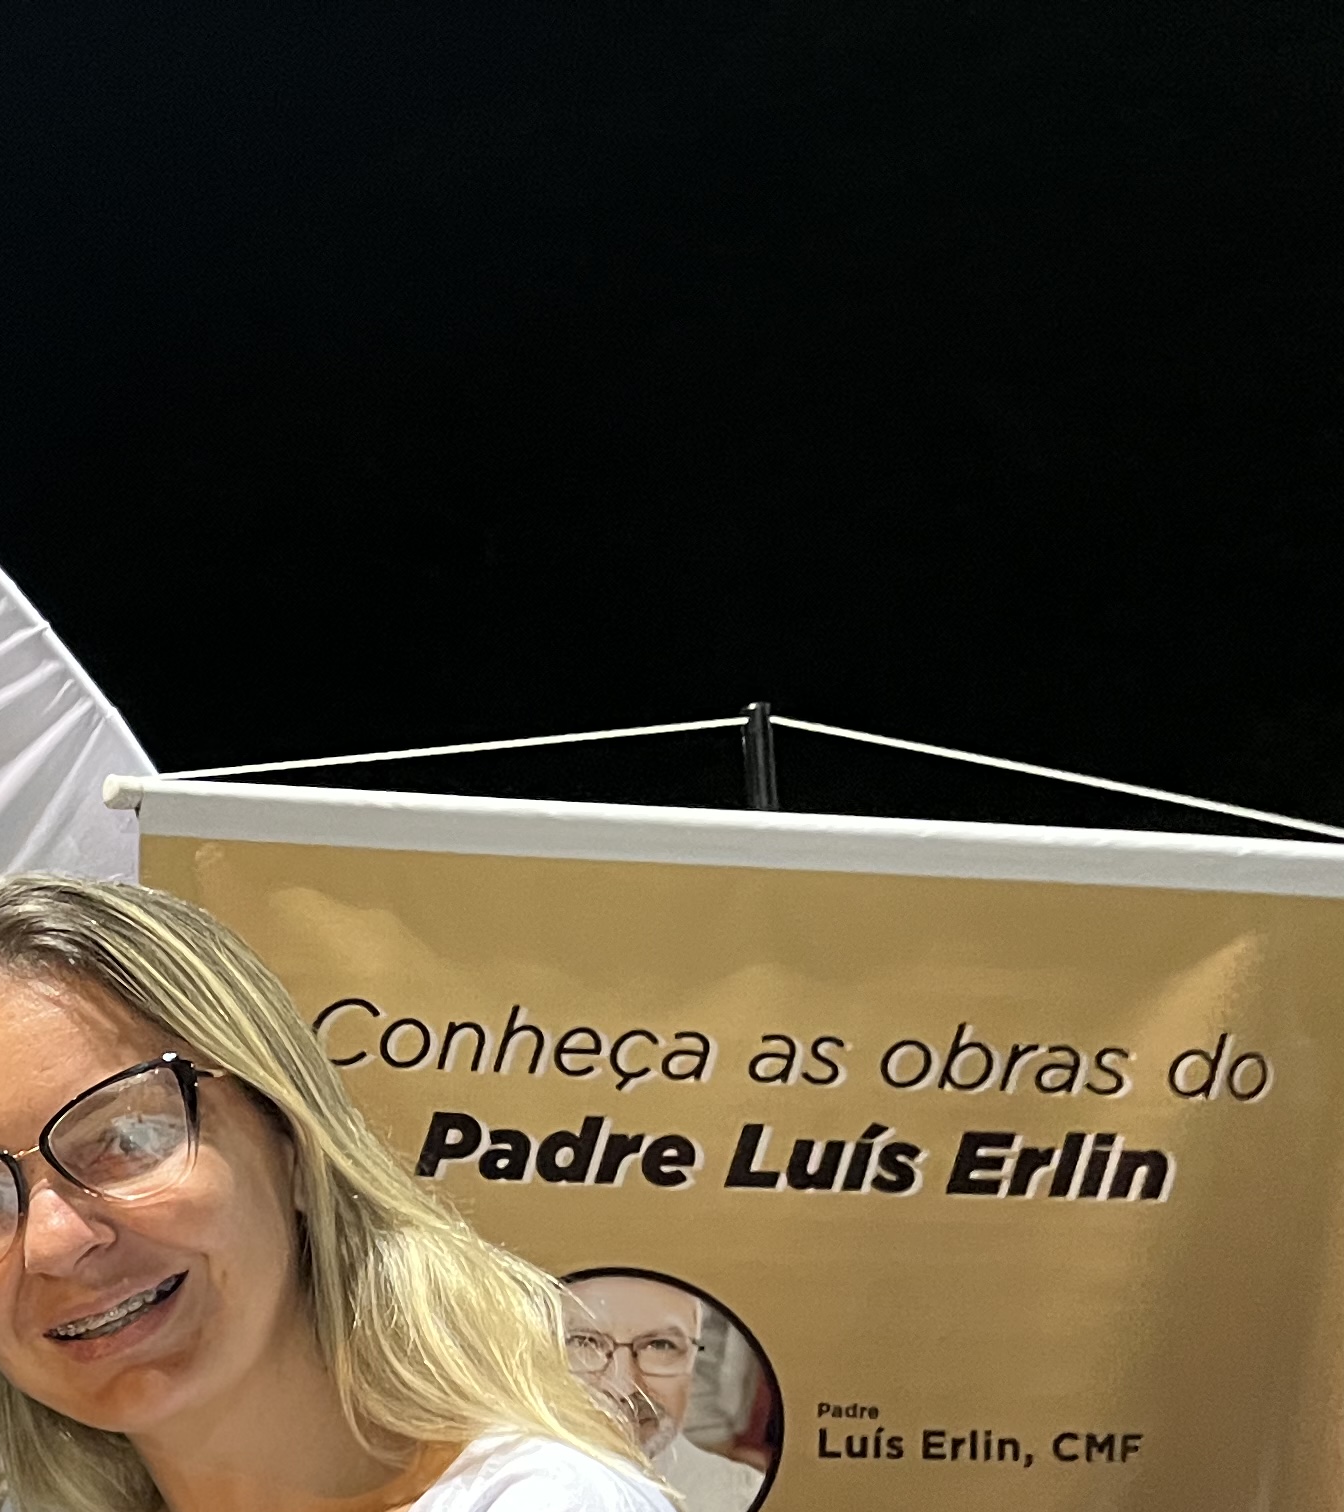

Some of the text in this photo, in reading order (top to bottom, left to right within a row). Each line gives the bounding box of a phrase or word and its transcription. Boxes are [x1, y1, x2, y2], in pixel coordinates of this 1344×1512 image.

[312, 998, 1270, 1100] Conheça as obras do
[415, 1111, 1172, 1200] Padre Luís Erlin
[817, 1402, 879, 1419] Padre
[818, 1426, 1144, 1468] Luís Erlin, CMF
